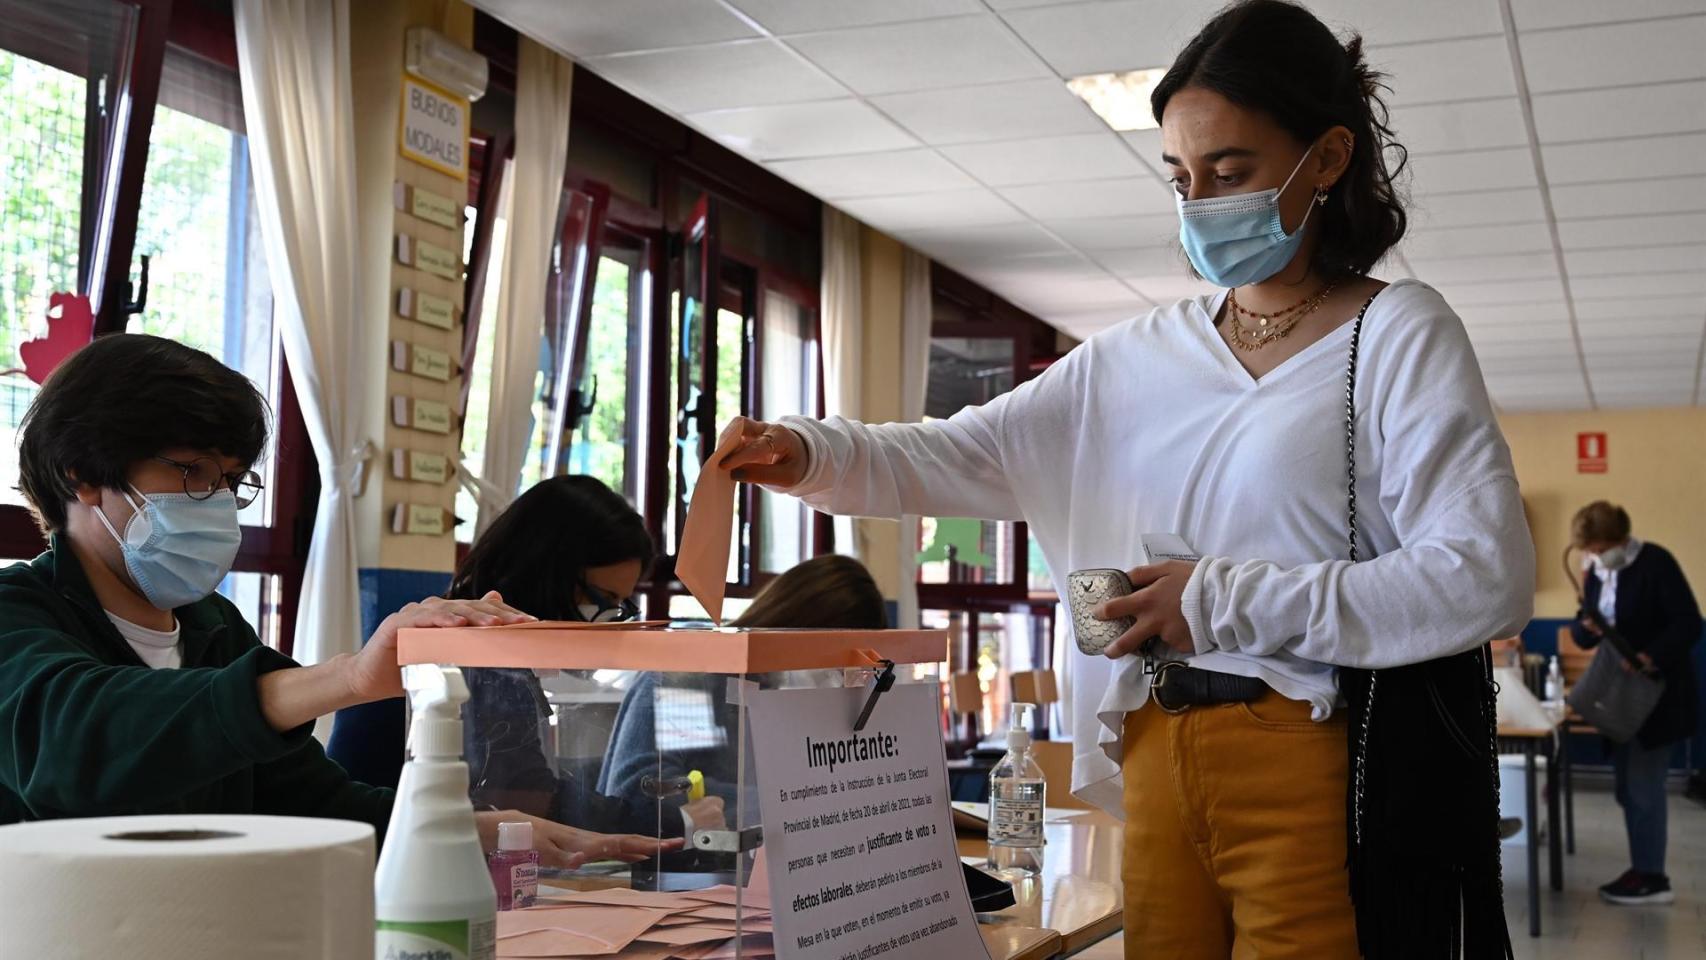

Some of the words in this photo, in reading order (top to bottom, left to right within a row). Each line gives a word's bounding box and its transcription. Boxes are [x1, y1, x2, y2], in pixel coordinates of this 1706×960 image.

[412, 87, 457, 127] BUENOS
[406, 126, 460, 166] MODALES
[807, 732, 898, 772] Importante:
[780, 789, 788, 802] En
[791, 785, 827, 801] cumplimiento
[831, 783, 837, 794] de
[840, 782, 845, 792] la
[848, 776, 875, 790] Instrucción
[877, 774, 883, 786] de
[886, 772, 891, 783] la
[893, 771, 906, 783] Junta
[909, 767, 929, 780] Electoral
[784, 816, 811, 834] Provincial
[812, 816, 819, 828] de
[821, 812, 840, 826] Madrid,
[842, 809, 849, 821] de
[849, 807, 863, 820] fecha
[864, 806, 871, 817] 20
[872, 804, 879, 816] de
[880, 801, 890, 814] abril
[892, 800, 898, 812] de
[912, 796, 924, 807] todas
[788, 856, 813, 873] personas
[817, 852, 828, 866] que
[831, 845, 855, 861] necesiten
[858, 842, 865, 852] un
[867, 832, 902, 855] justificante
[905, 827, 913, 841] de
[916, 826, 929, 839] voto
[932, 824, 936, 835] a
[793, 892, 820, 913] efectos
[821, 882, 855, 904] laborales,
[855, 878, 877, 894] deberán
[877, 873, 895, 890] pedirlo
[896, 872, 899, 882] a
[899, 867, 907, 880] los
[908, 862, 930, 878] miembros
[931, 860, 937, 872] de
[938, 858, 942, 869] la
[797, 933, 814, 950] Mesa
[815, 932, 823, 944] en
[824, 928, 830, 940] la
[831, 925, 842, 940] que
[861, 916, 870, 927] en
[870, 912, 876, 924] el
[876, 905, 901, 924] momento
[902, 902, 908, 914] de
[909, 897, 924, 911] emitir
[925, 897, 930, 906] su
[943, 890, 950, 903] ya
[858, 940, 890, 960] justificantes
[890, 937, 898, 948] de
[898, 933, 910, 947] voto
[910, 930, 920, 941] una
[921, 928, 929, 939] vez
[929, 916, 958, 935] abandonado
